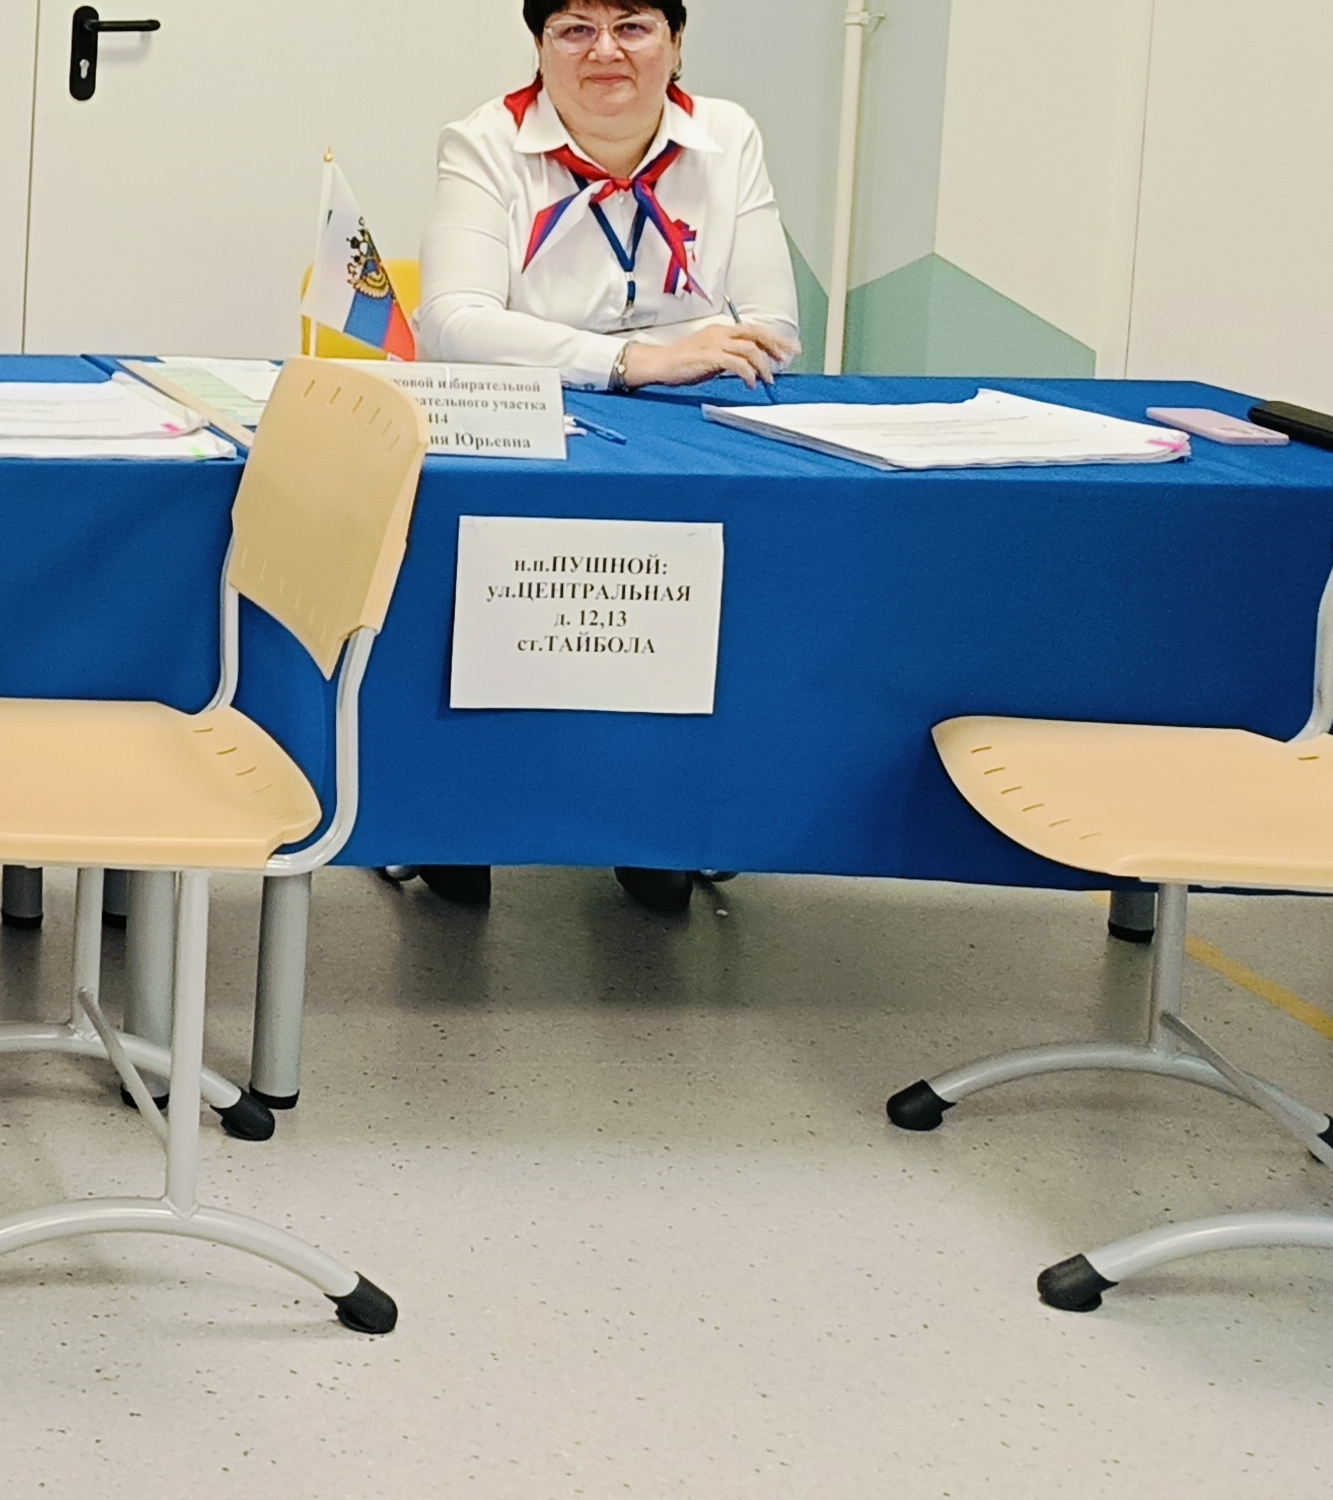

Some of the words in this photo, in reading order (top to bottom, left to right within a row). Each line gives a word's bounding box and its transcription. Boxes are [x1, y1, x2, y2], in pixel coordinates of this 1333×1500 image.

[492, 399, 547, 412] участка
[455, 431, 531, 451] Юрьевна
[514, 554, 668, 575] н.п.ПУШНОЙ:
[486, 582, 691, 602] ул.ЦЕНТРАЛЬНАЯ
[553, 613, 571, 628] д.
[579, 609, 628, 629] 12,13
[517, 632, 656, 654] ст.ТАЙБОЛА
